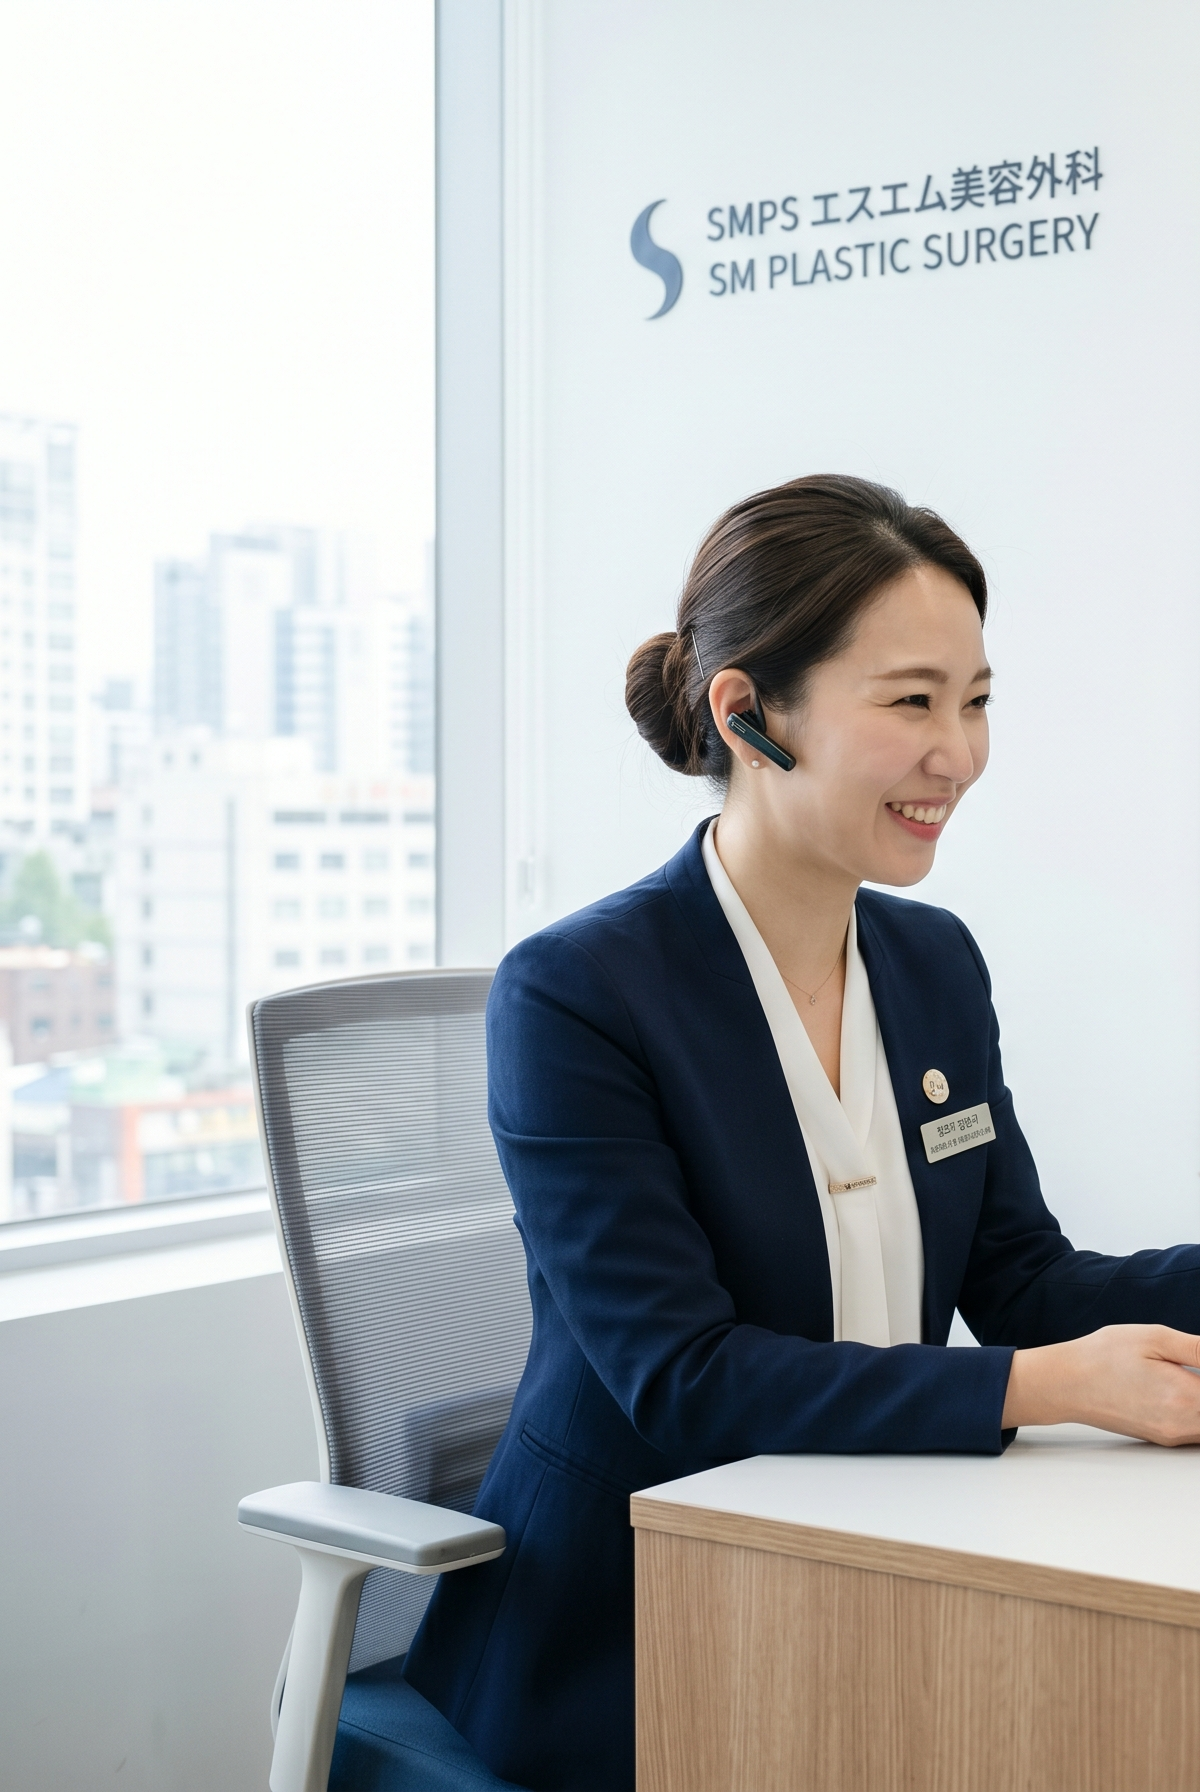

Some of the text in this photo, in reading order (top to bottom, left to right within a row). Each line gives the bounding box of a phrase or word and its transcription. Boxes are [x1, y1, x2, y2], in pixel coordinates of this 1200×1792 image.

[706, 146, 1104, 241] SMPS エスエム美容外科
[709, 212, 1100, 296] SM PLASTIC SURGERY
